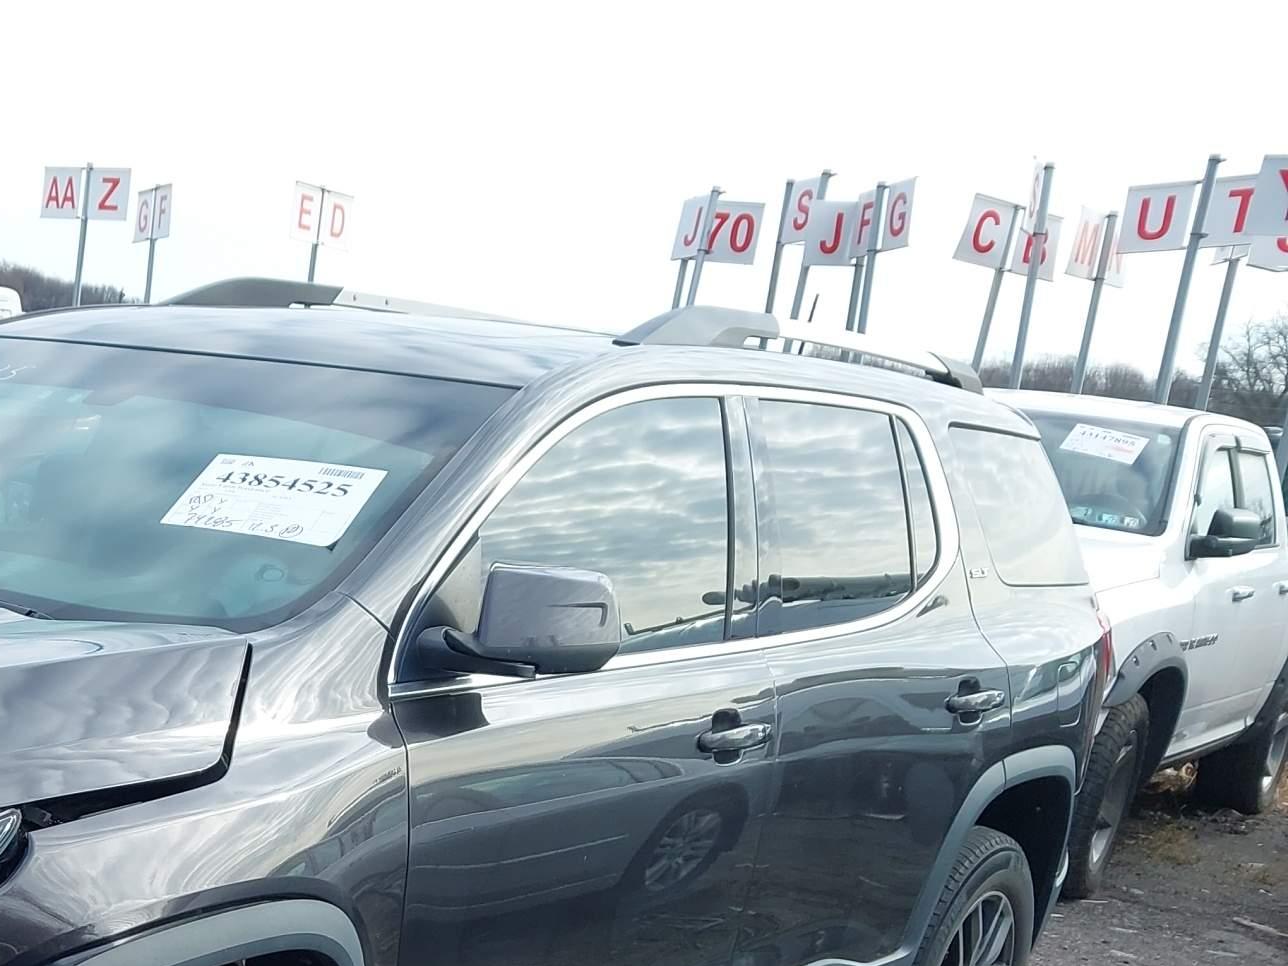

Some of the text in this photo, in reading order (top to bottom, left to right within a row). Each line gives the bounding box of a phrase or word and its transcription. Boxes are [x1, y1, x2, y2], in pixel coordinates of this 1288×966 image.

[45, 176, 77, 209] AA
[97, 177, 121, 211] Z
[157, 194, 168, 229] F
[297, 193, 314, 231] E
[793, 189, 813, 231] S
[138, 200, 149, 233] G
[330, 202, 346, 239] D
[683, 206, 703, 247] J
[707, 212, 755, 253] 70
[819, 212, 844, 254] J
[857, 202, 874, 245] F
[889, 192, 908, 237] G
[972, 208, 1001, 254] C
[1136, 195, 1177, 240] U
[1074, 222, 1100, 266] M
[215, 470, 354, 498] 43854525
